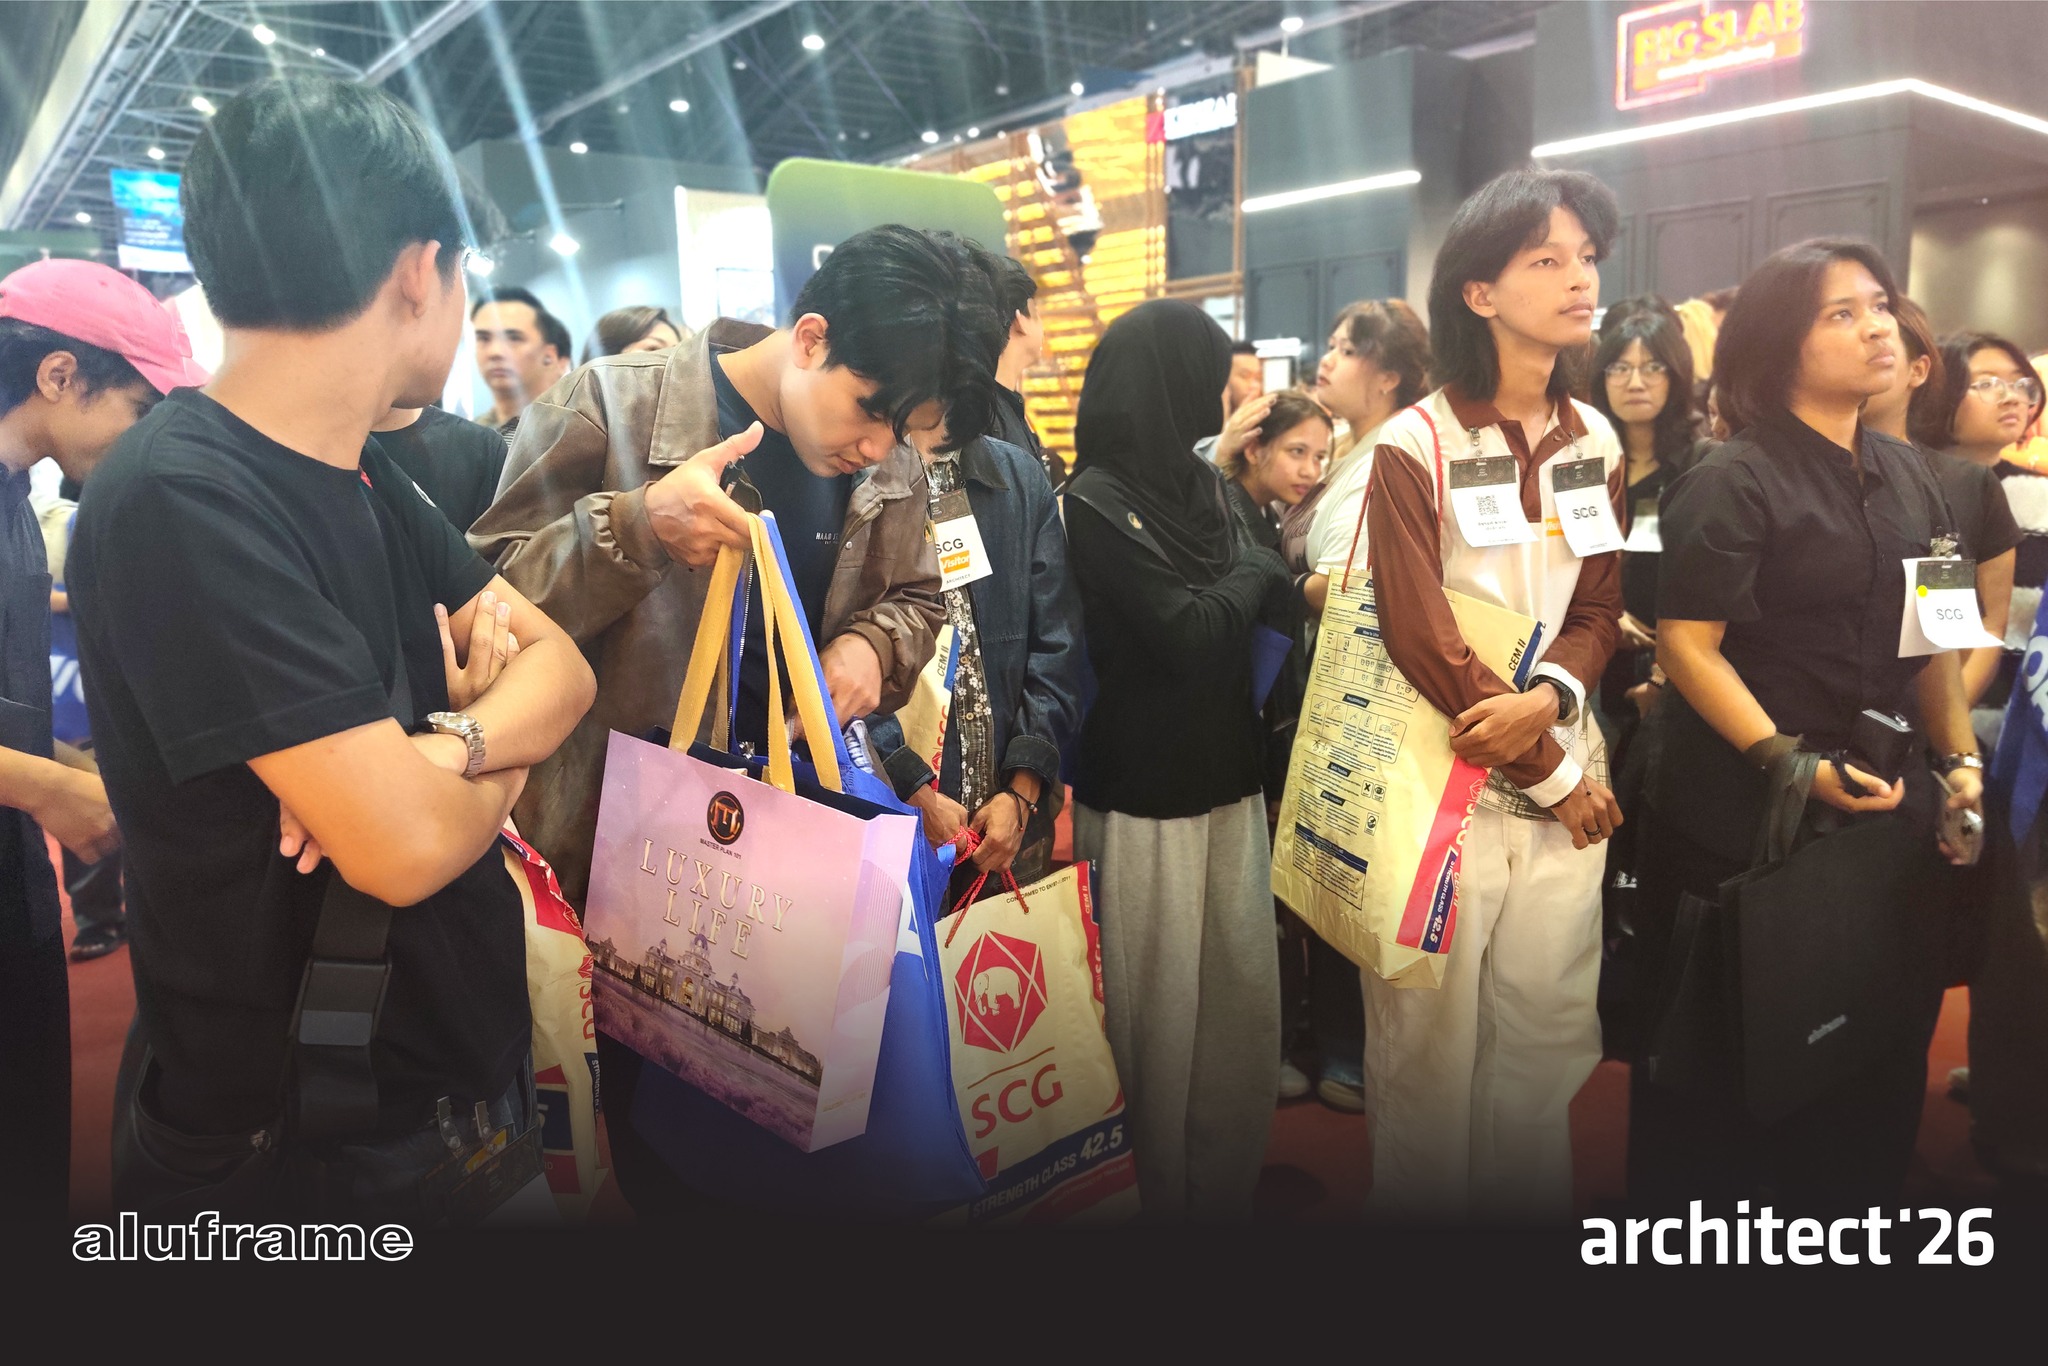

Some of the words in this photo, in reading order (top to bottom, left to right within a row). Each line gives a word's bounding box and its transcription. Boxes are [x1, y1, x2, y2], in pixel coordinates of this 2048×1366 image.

[1633, 20, 1698, 66] BIG
[1702, 0, 1806, 50] SLAB
[1572, 505, 1599, 520] SCG
[936, 538, 963, 554] SCG
[943, 555, 970, 569] Visitor
[1936, 608, 1964, 620] SCG
[937, 653, 946, 677] CEM
[1508, 648, 1522, 671] CEM
[700, 837, 720, 851] MASTER
[720, 846, 733, 856] PLAN
[733, 851, 742, 860] 101
[640, 838, 792, 932] LUXURY
[663, 888, 752, 959] LIFE
[971, 1063, 1064, 1139] SCG
[972, 1174, 1039, 1219] STRENGTH
[1041, 1153, 1077, 1184] CLASS
[1080, 1124, 1123, 1160] 42.5
